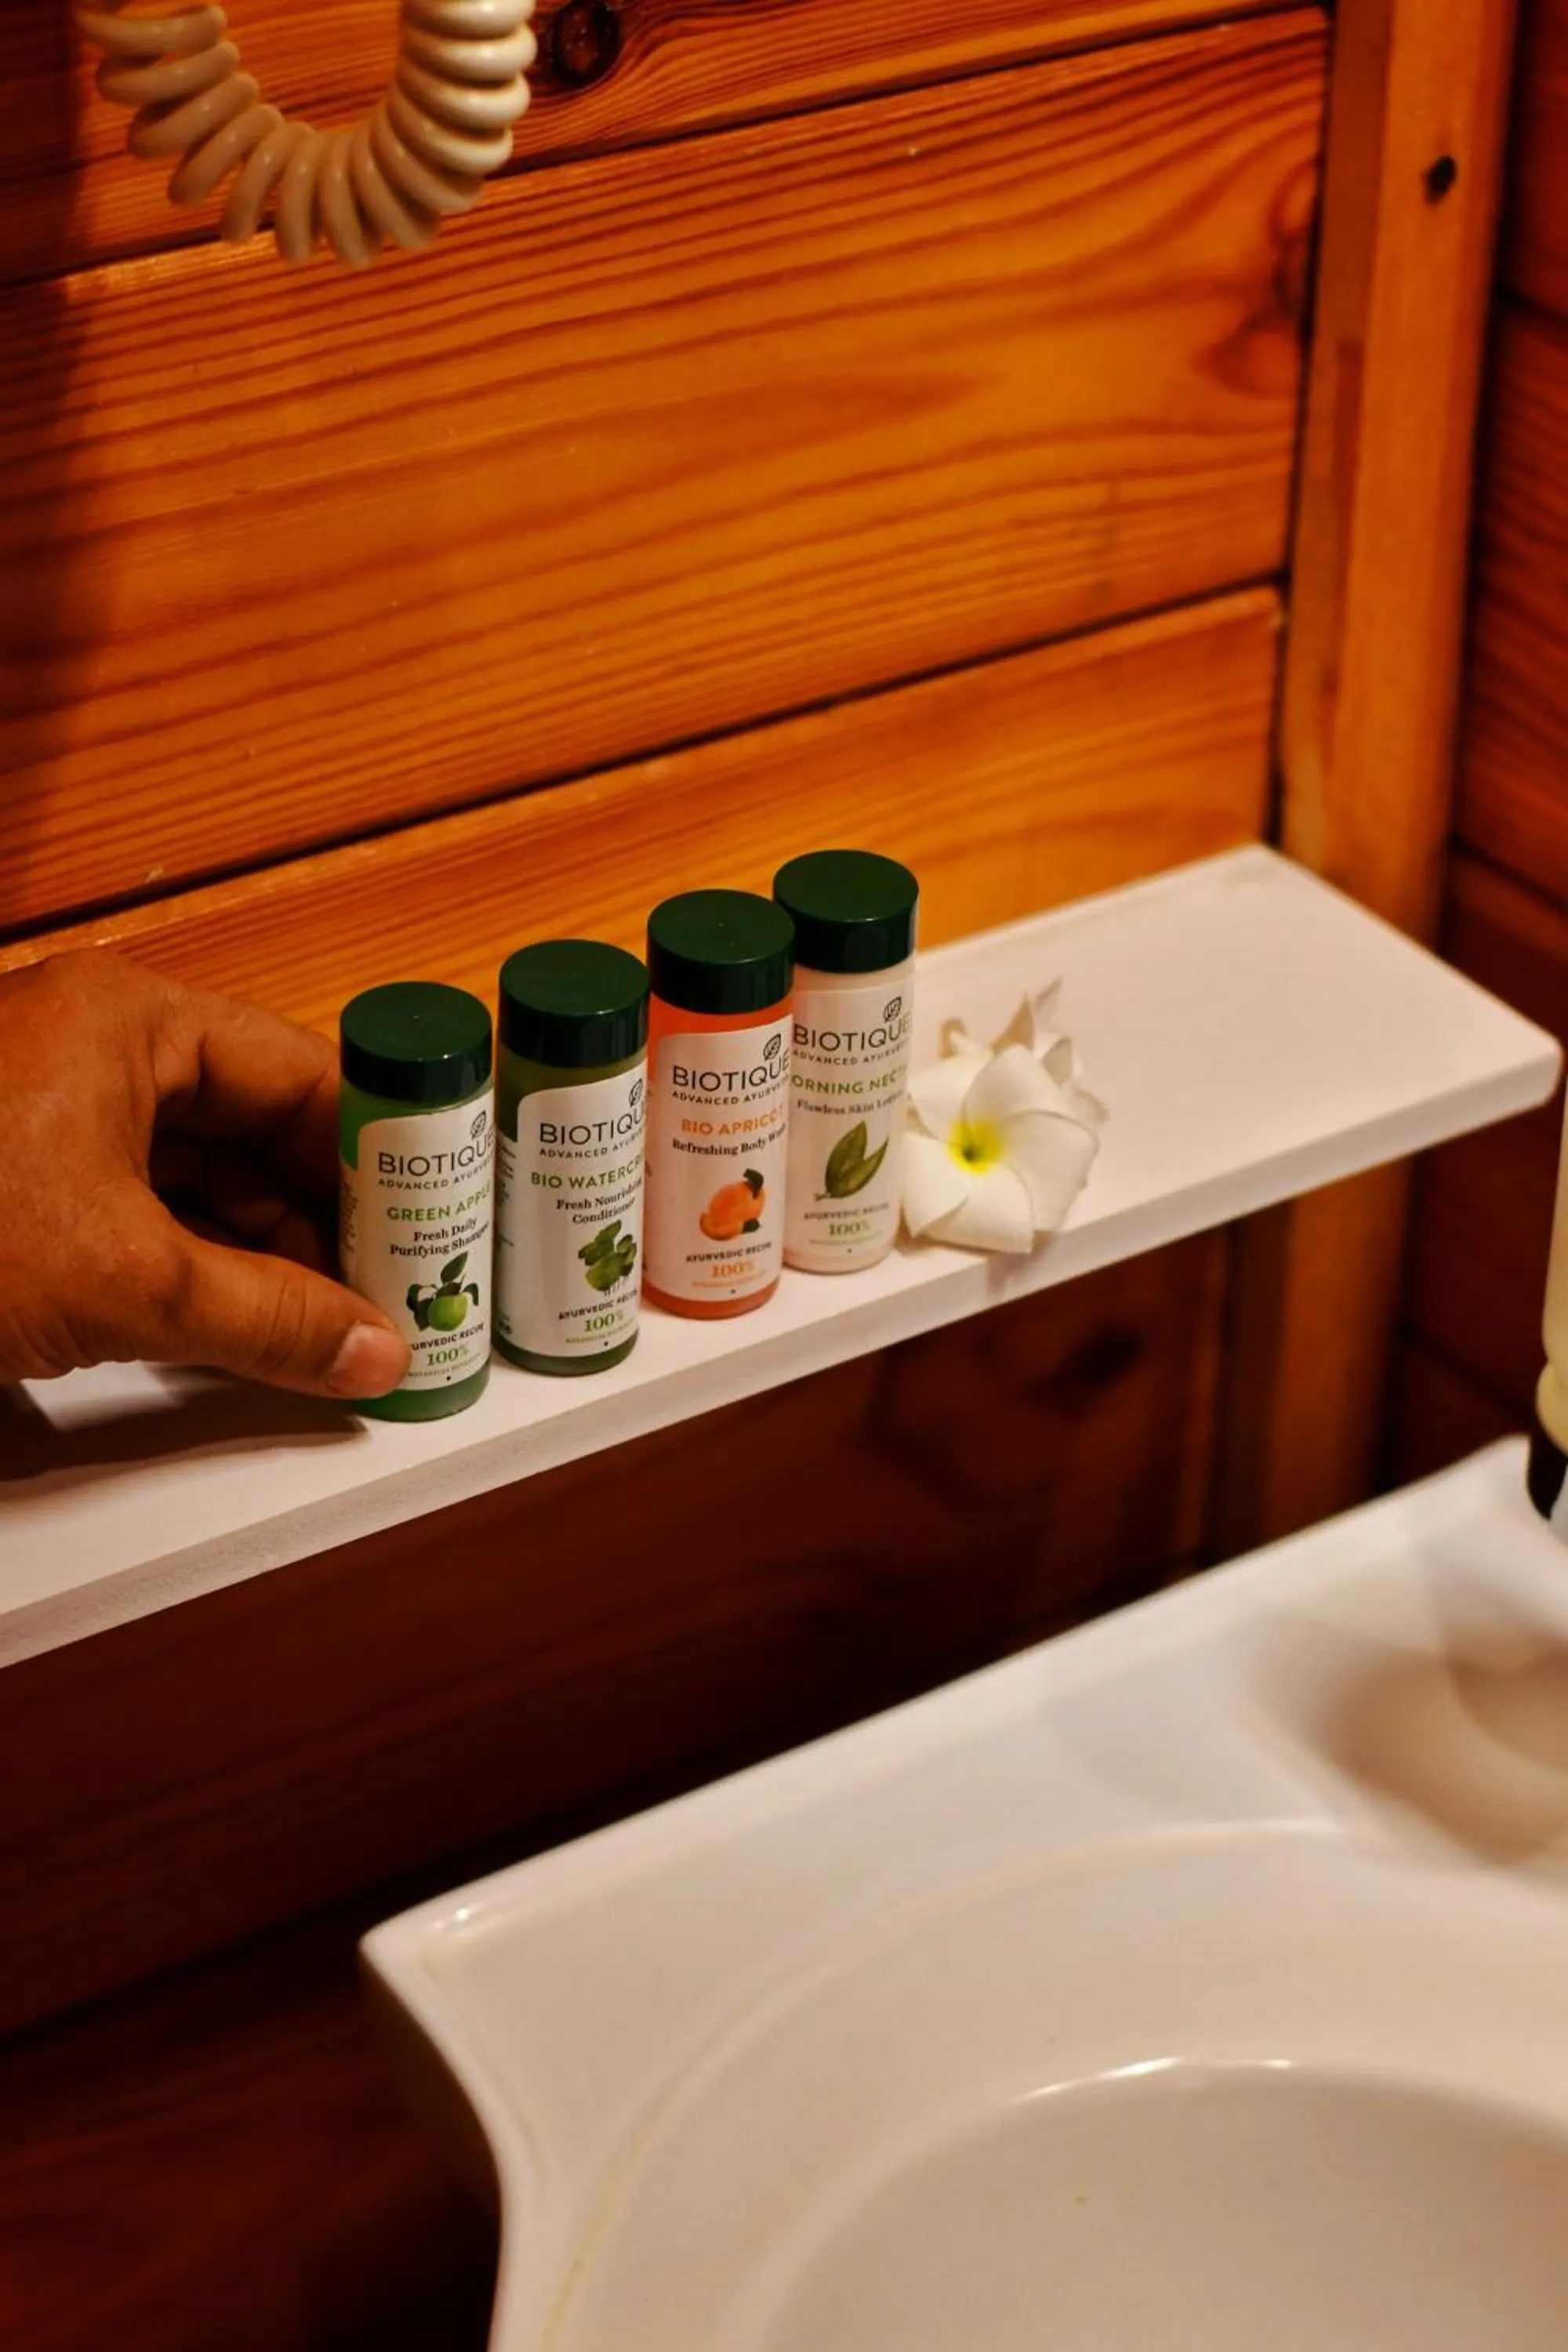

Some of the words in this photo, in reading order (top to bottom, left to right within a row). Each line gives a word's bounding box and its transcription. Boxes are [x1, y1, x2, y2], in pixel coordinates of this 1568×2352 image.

[793, 1050, 858, 1065] ADVANCED
[673, 1047, 790, 1092] BIOTIQUE
[790, 1074, 863, 1094] ORNING
[672, 1091, 739, 1105] ADVANCED
[797, 1098, 846, 1115] Flawless
[540, 1099, 645, 1145] BIOTIQU
[681, 1119, 713, 1134] BIO
[539, 1148, 608, 1159] ADVANCED
[673, 1138, 738, 1156] Refreshing
[741, 1138, 766, 1153] Body
[378, 1178, 449, 1190] ADVANCED
[531, 1172, 563, 1189] BIO
[557, 1199, 593, 1210] Fresh
[387, 1205, 452, 1221] GREEN
[414, 1229, 449, 1242] Fresh
[452, 1216, 477, 1236] Daily
[390, 1244, 450, 1258] Purifying
[686, 1249, 743, 1262] AYURVEDIC
[559, 1300, 614, 1320] AYURVEDIC
[411, 1334, 458, 1351] URVEDIC
